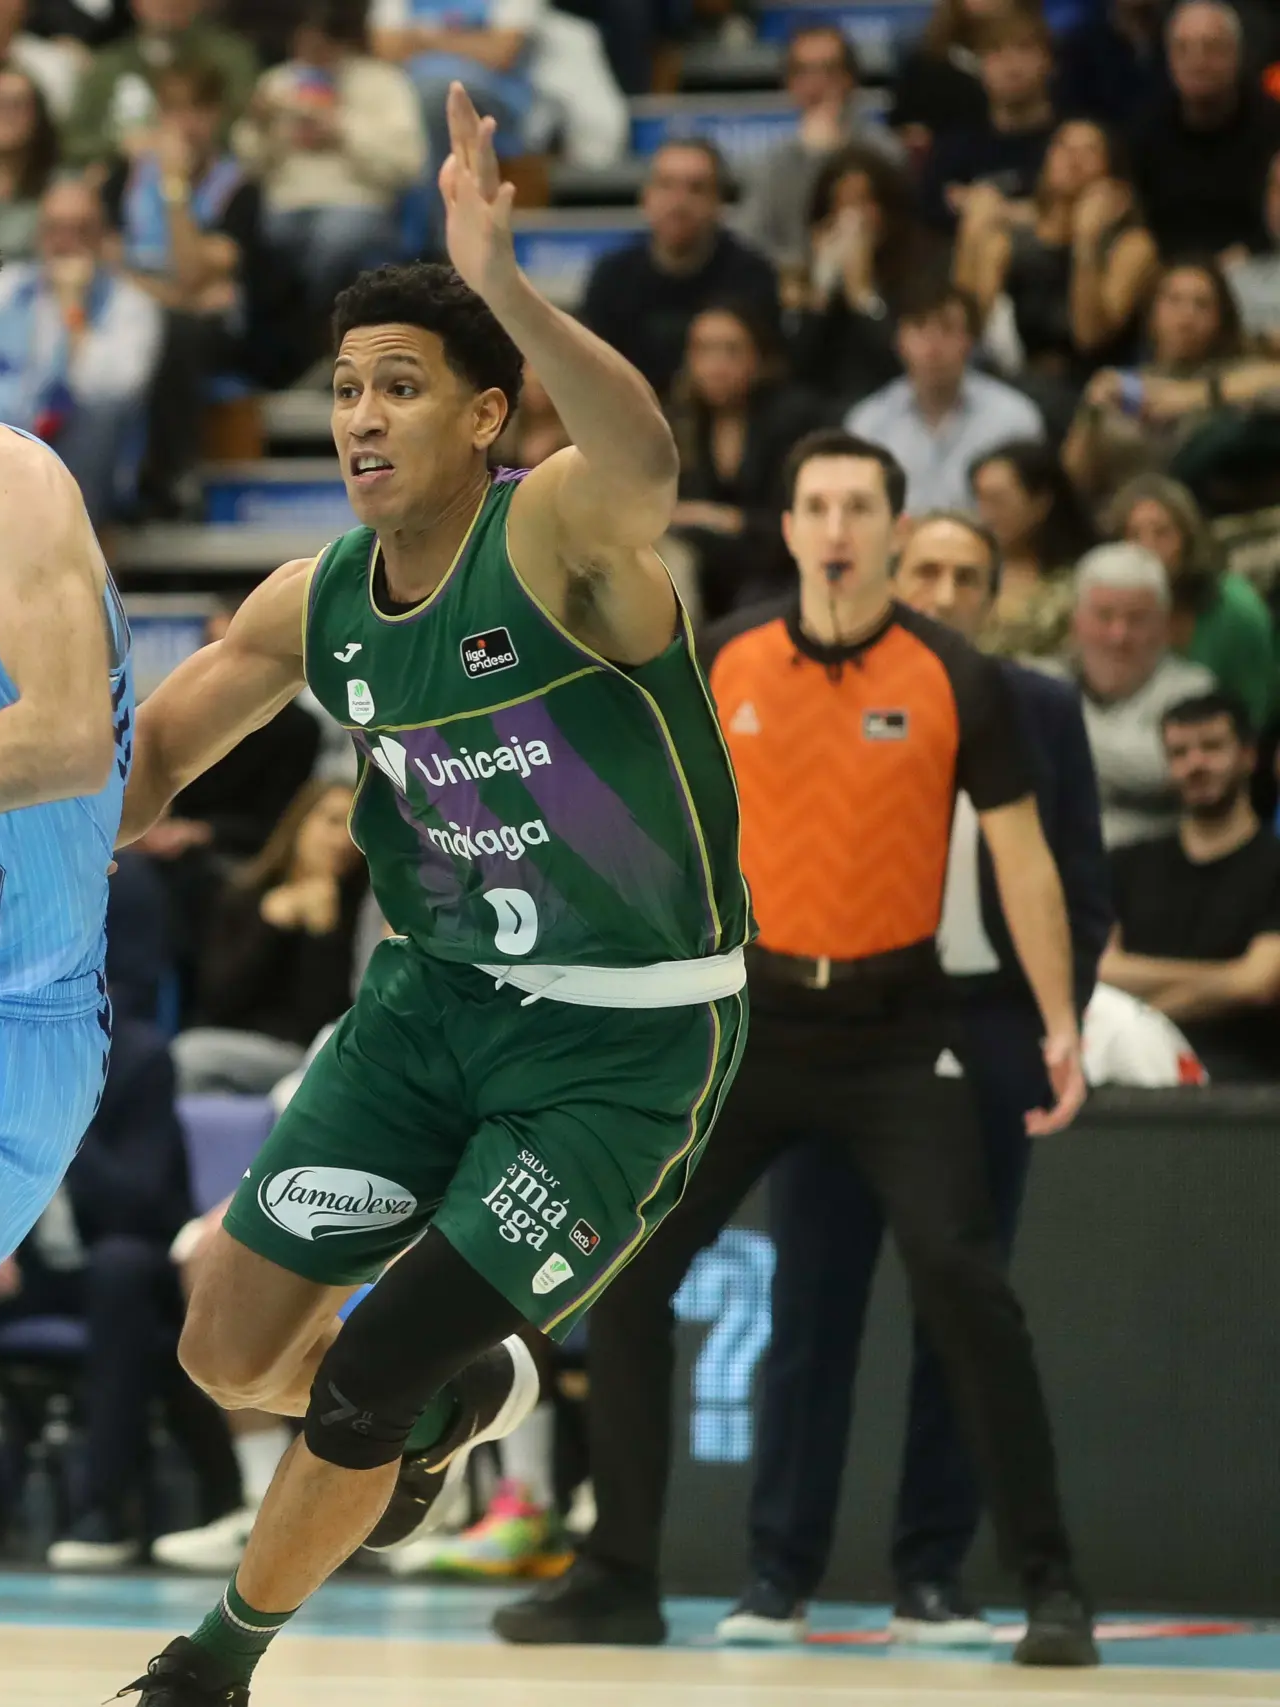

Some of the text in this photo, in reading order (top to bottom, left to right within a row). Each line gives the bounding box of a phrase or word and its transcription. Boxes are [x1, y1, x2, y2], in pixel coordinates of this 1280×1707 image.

[465, 649, 486, 662] liga
[470, 652, 513, 672] endesa
[414, 736, 552, 786] Unicaja
[427, 819, 550, 861] málaga
[573, 1230, 591, 1249] acb
